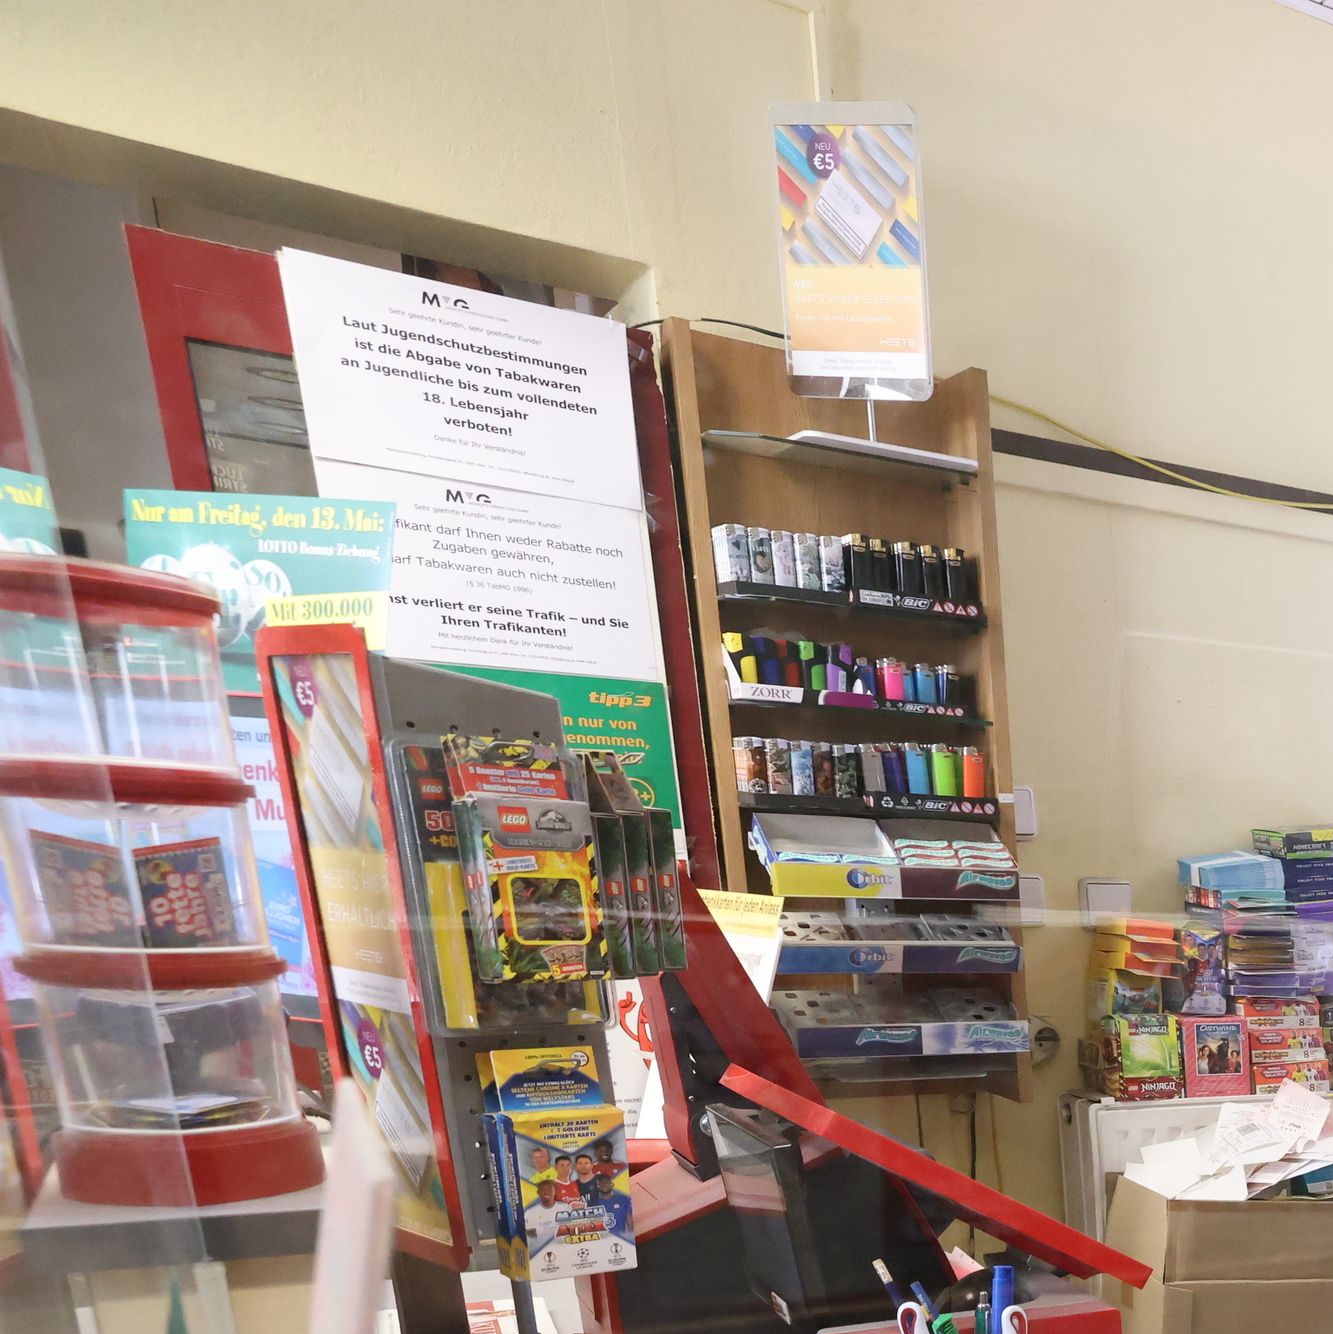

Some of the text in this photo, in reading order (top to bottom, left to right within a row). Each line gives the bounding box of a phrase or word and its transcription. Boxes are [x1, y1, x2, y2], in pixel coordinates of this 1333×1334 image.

[815, 142, 831, 150] NEU
[813, 154, 834, 170] €5
[342, 316, 377, 332] Laut
[381, 323, 588, 376] Jugendschutzbestimmungen
[355, 338, 581, 394] ist die Abgabe von Tabakwaren
[341, 356, 597, 416] an Jugendliche bis zum vollendeten
[423, 392, 529, 422] 18. Lebensjahr
[444, 416, 513, 437] verboten!
[132, 499, 164, 524] Nur
[168, 506, 194, 524] am
[199, 502, 265, 536] Freitag,
[272, 506, 306, 529] den
[310, 506, 340, 530] 13.
[258, 540, 298, 554] LOTTO
[436, 525, 461, 537] darf
[466, 528, 501, 541] Ihnen
[506, 533, 541, 547] weder
[546, 539, 592, 554] Rabatte
[595, 545, 623, 558] noch
[432, 540, 555, 566] Zugaben gewähren,
[416, 557, 493, 576] Tabakwaren
[497, 567, 525, 579] auch
[530, 570, 558, 583] nicht
[563, 574, 616, 590] zustellen!
[272, 598, 373, 622] Mit 300.000
[412, 596, 464, 611] verliert
[468, 603, 482, 612] er
[486, 604, 523, 618] seine
[526, 609, 565, 622] Trafik
[581, 615, 606, 626] und
[610, 618, 630, 629] Sie
[441, 615, 567, 637] Ihren Trafikanten!
[589, 692, 651, 707] tipp3
[751, 687, 792, 699] ZORR
[579, 718, 637, 730] nur von
[502, 815, 527, 824] LEGO
[1141, 1083, 1176, 1092] NINJAGO
[556, 1206, 605, 1220] MATCH
